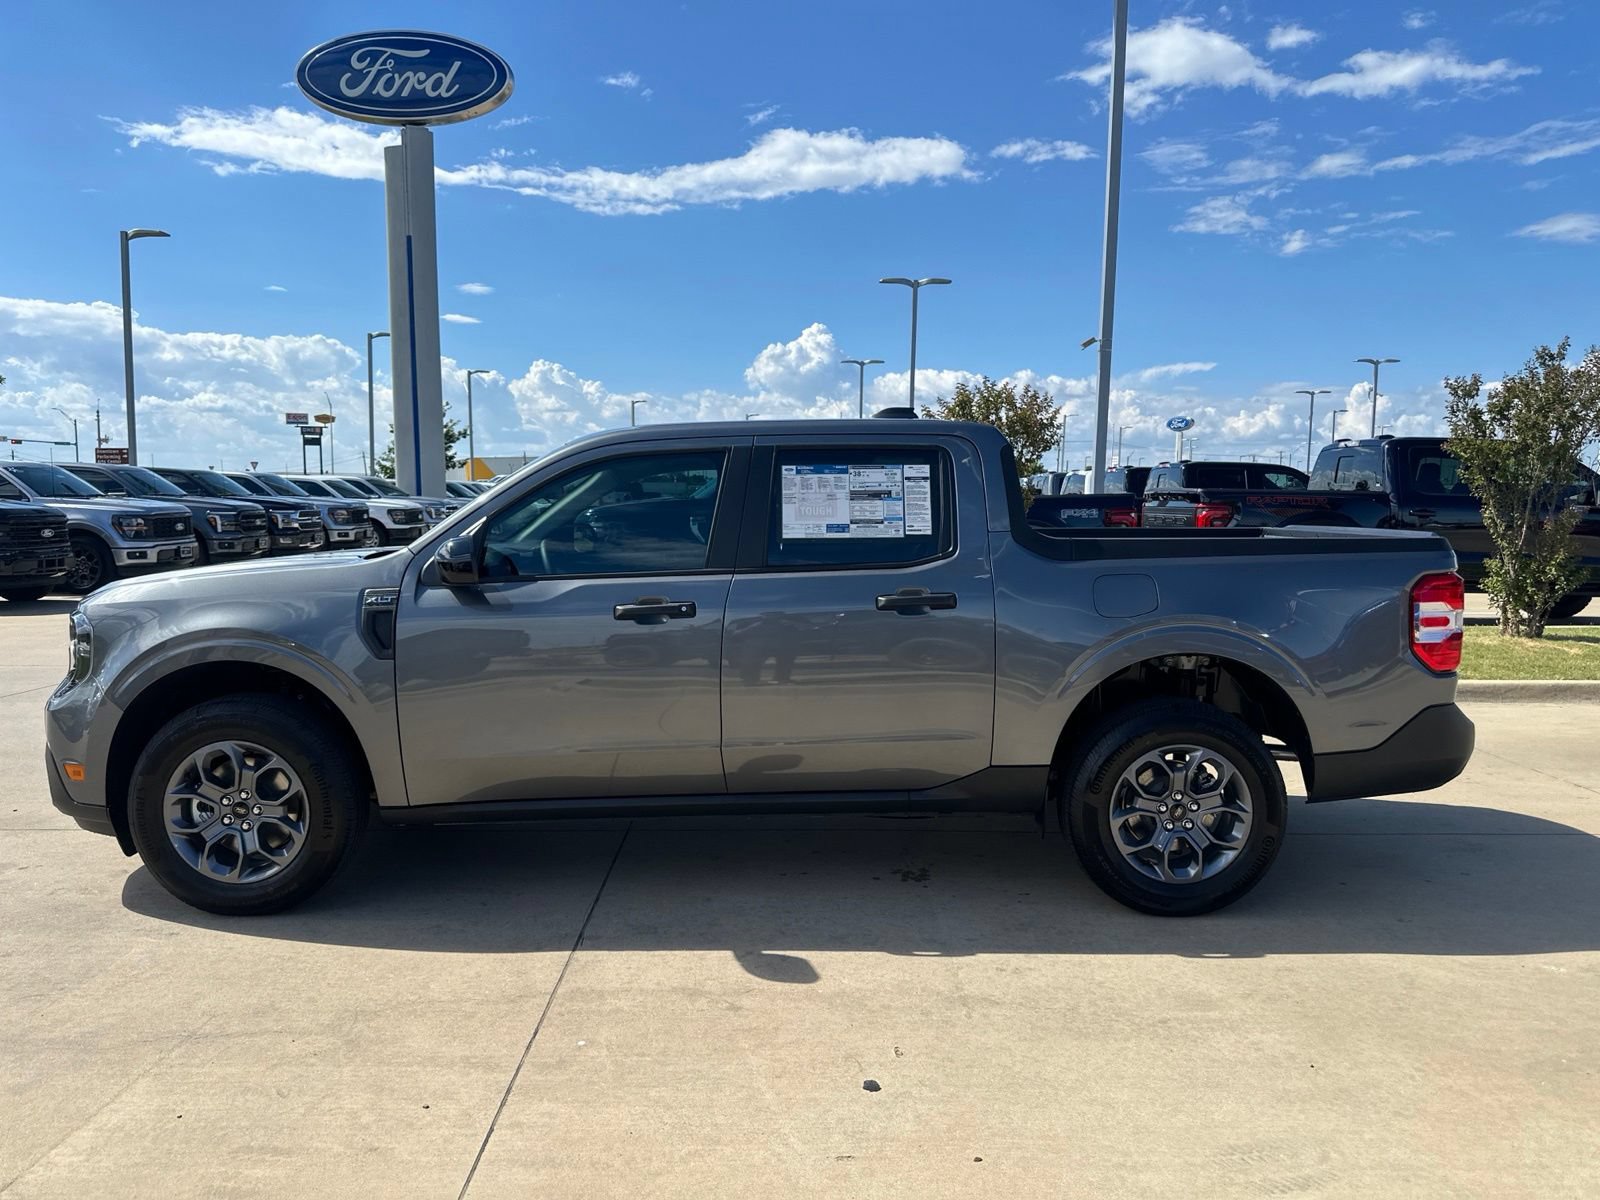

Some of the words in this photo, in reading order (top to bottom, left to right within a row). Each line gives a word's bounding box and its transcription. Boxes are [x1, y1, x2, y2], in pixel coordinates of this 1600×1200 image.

[340, 47, 462, 98] Ford
[1246, 496, 1329, 507] RAPTOR
[800, 506, 832, 515] TOUGH
[1060, 508, 1098, 518] FX4
